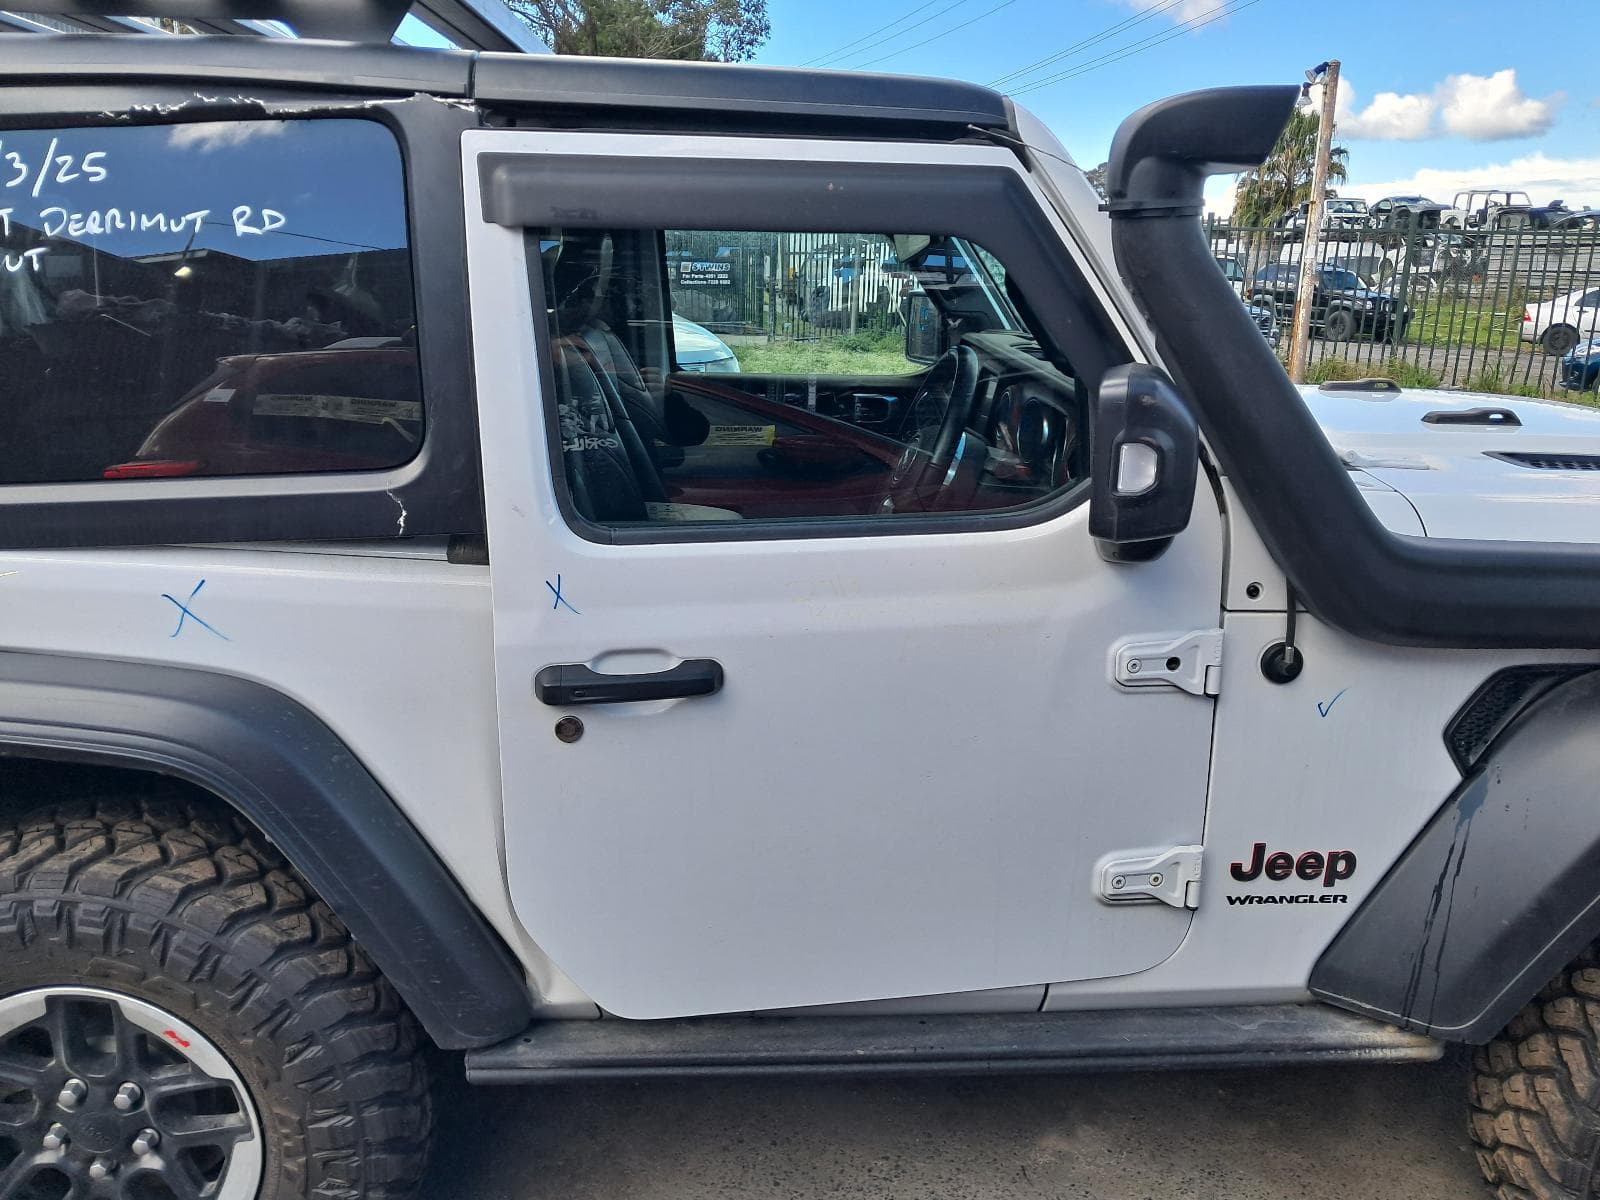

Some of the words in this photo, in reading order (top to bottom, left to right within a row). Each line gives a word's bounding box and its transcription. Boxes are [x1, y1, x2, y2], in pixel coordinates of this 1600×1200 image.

[232, 205, 286, 237] RD
[1230, 843, 1357, 887] Jeep
[1226, 895, 1348, 905] WRANGLER
